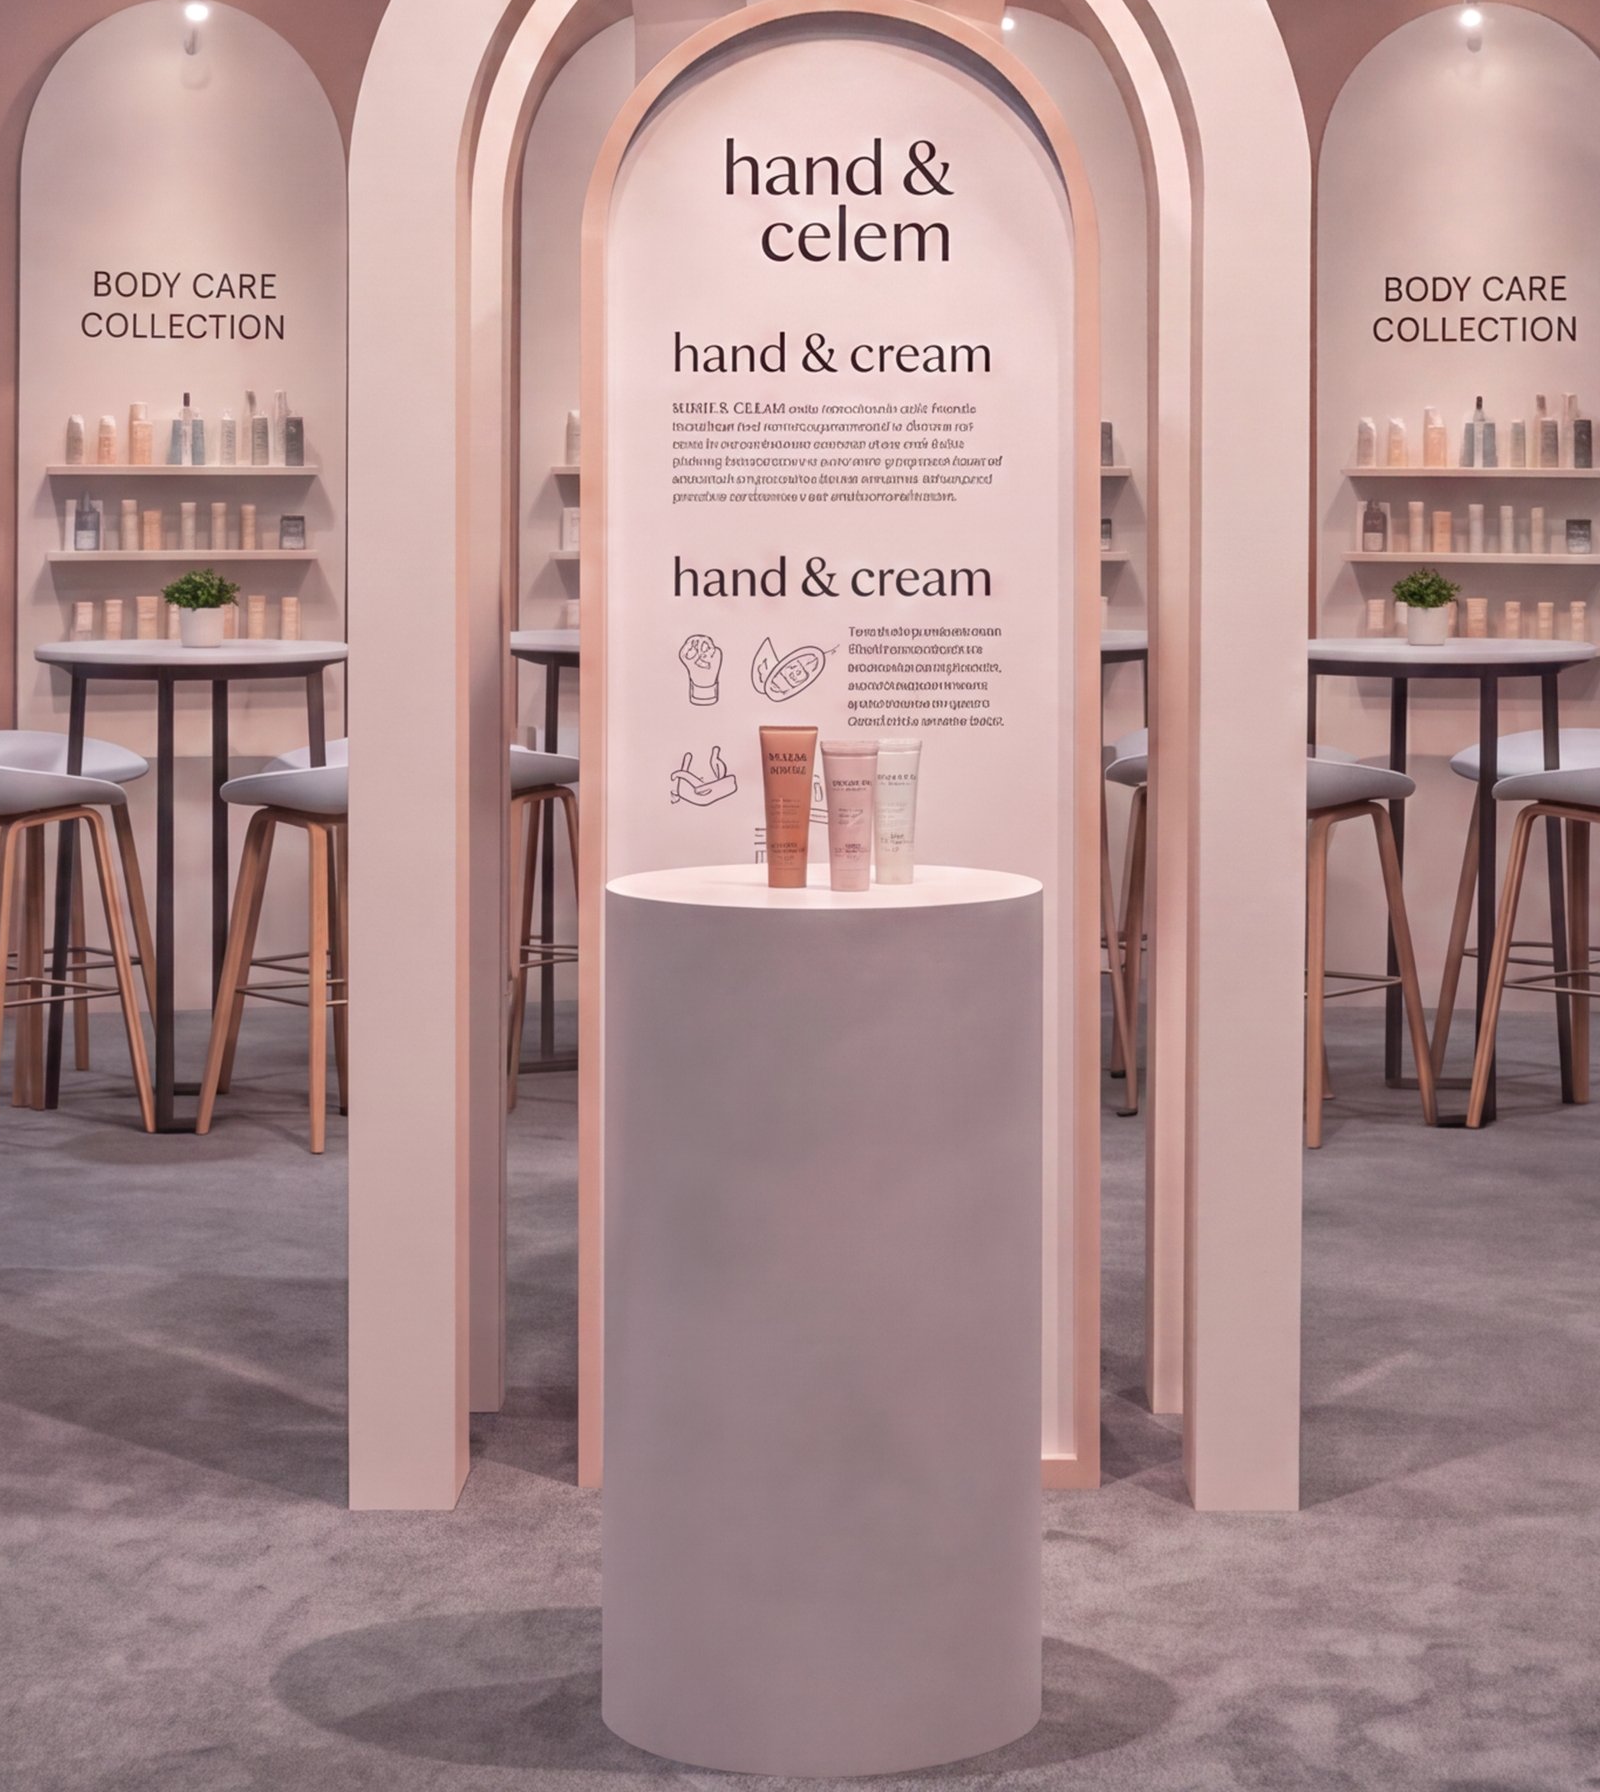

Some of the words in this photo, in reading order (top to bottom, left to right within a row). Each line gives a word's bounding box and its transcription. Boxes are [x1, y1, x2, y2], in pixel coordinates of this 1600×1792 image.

[725, 138, 882, 196] hand
[903, 139, 954, 196] &
[761, 204, 950, 262] celem
[93, 270, 181, 298] BODY
[192, 272, 277, 300] CARE
[1385, 276, 1471, 302] BODY
[1482, 275, 1567, 302] CARE
[81, 311, 284, 340] COLLECTION
[1372, 315, 1577, 343] COLLECTION
[674, 331, 786, 373] hand
[801, 332, 838, 373] &
[850, 344, 991, 373] cream
[674, 555, 786, 598] hand
[801, 556, 840, 598] &
[851, 568, 991, 597] cream
